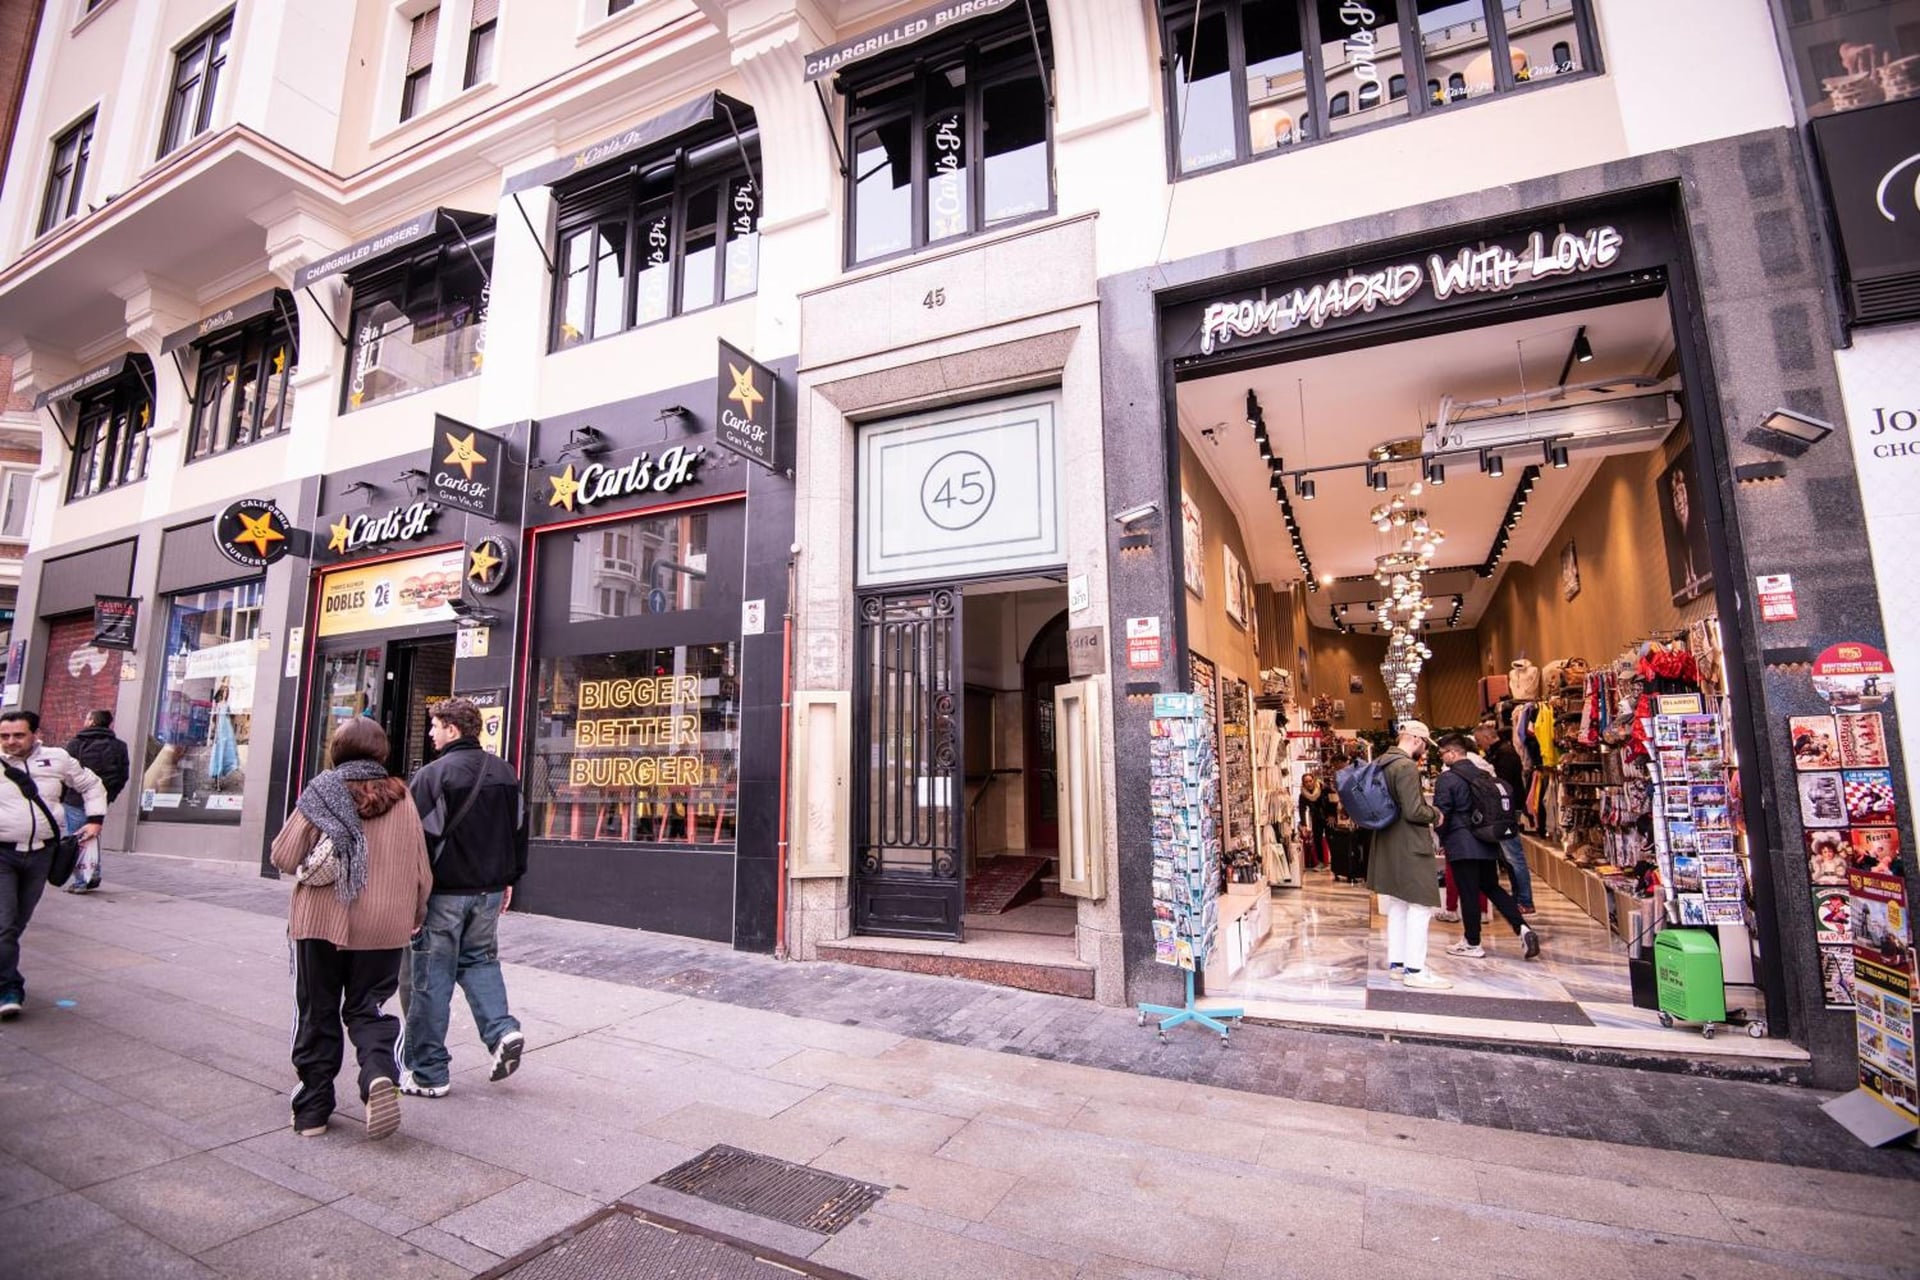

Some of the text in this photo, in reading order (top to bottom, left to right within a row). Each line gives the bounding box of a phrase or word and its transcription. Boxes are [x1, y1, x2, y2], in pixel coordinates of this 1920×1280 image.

[806, 0, 1003, 75] CHARGRILLED BURGE
[936, 115, 960, 149] Jr.
[734, 179, 755, 214] Jr.
[649, 216, 668, 248] Jr.
[306, 223, 420, 281] CHARGRILLED BURGERS
[922, 286, 946, 309] 45
[1202, 226, 1621, 353] FROM MADRID WITH LOVE
[722, 409, 765, 444] Carl's Jr.
[1870, 407, 1920, 435] JO
[435, 472, 486, 498] Carl's Jr.
[577, 446, 697, 503] Carl's Jr.
[932, 470, 985, 509] 45
[240, 500, 290, 530] CALIFORNIA
[473, 500, 484, 509] 45
[348, 502, 432, 548] Carl's Jr.
[225, 542, 267, 566] BURGERS
[326, 590, 366, 613] DOBLES
[578, 675, 698, 710] BIGGER
[575, 715, 699, 748] BETTER
[570, 756, 701, 787] BURGER
